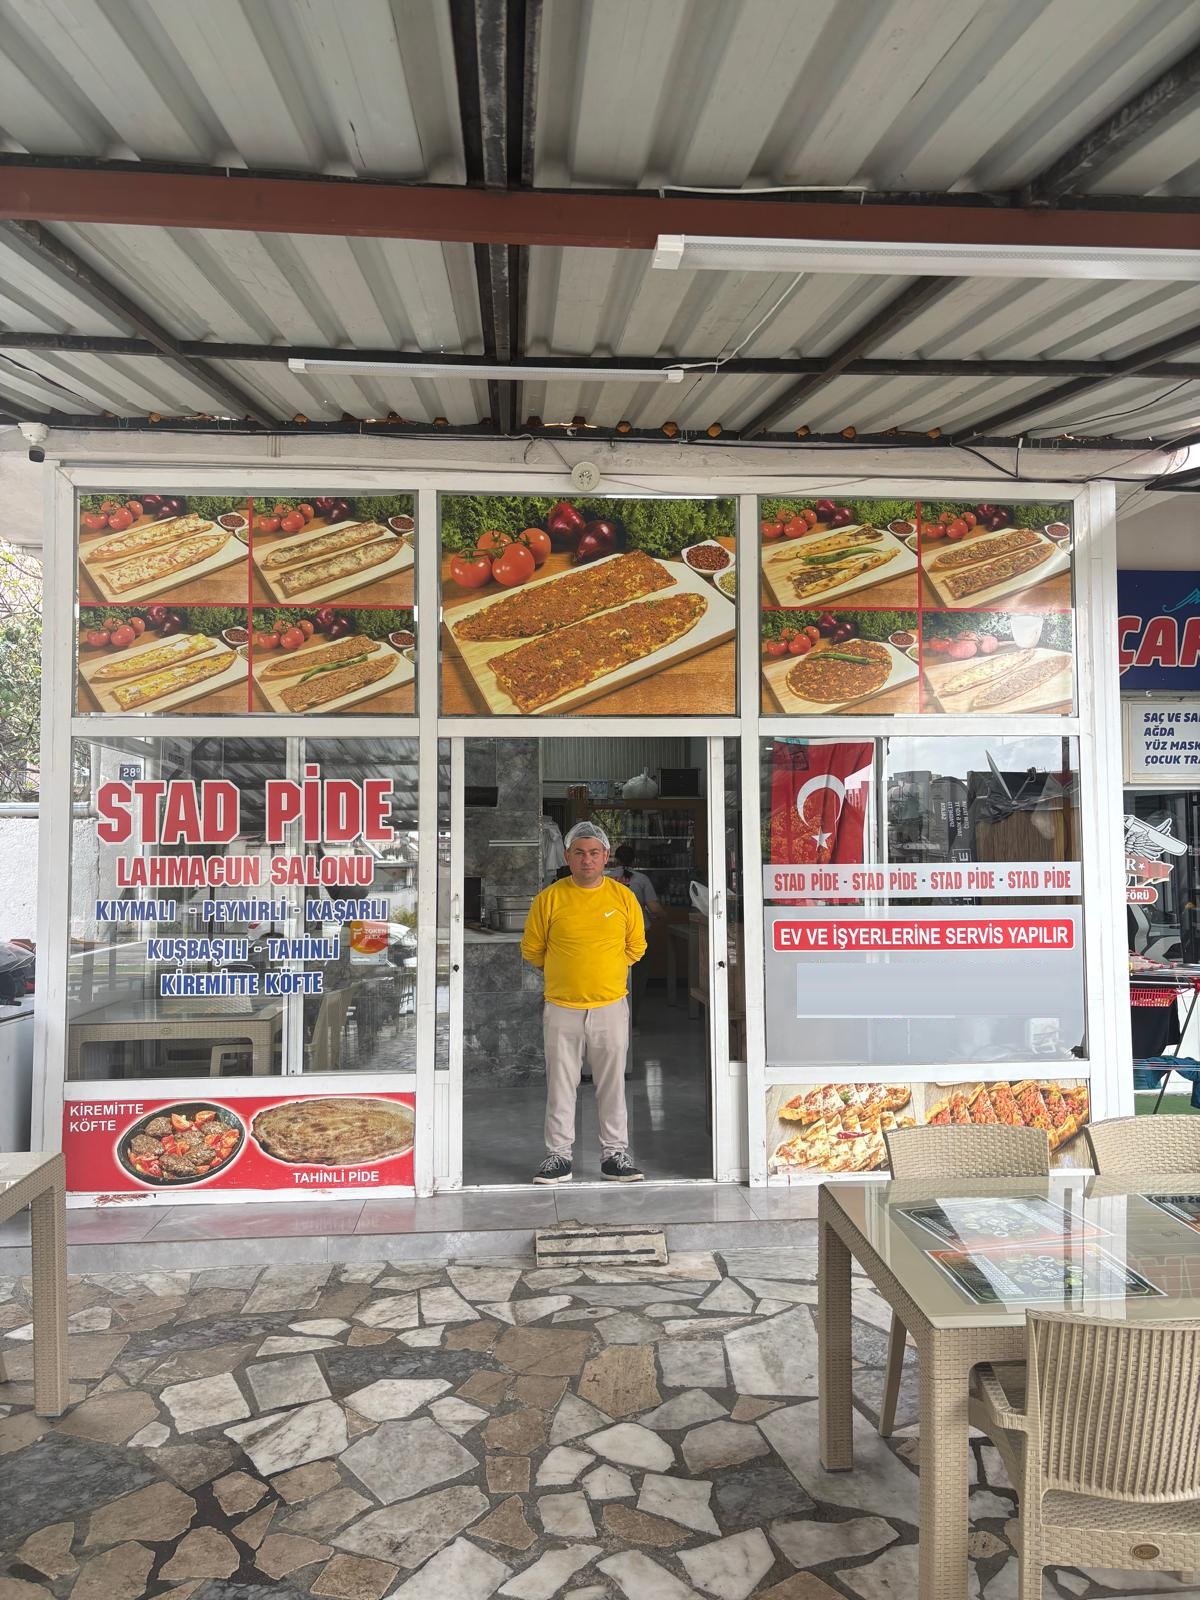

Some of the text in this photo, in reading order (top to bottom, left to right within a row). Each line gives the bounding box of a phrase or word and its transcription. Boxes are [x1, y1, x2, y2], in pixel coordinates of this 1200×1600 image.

[1144, 712, 1200, 724] SAÇ VE SA
[1144, 725, 1174, 736] AĞDA
[1145, 739, 1167, 750] YÜZ
[1145, 755, 1200, 766] ÇOCUK TR
[96, 763, 394, 844] STAD PİDE
[116, 855, 374, 887] LAHMACUN SALONU
[774, 873, 805, 891] STAD
[811, 868, 839, 891] PİDE
[852, 872, 884, 890] STAD
[889, 867, 917, 890] PİDE
[930, 871, 962, 889] STAD
[967, 867, 995, 889] PİDE
[1008, 871, 1039, 889] STAD
[1044, 866, 1071, 888] PİDE
[96, 900, 176, 922] KIYMALI
[202, 896, 287, 922] PEYNİRLİ
[306, 899, 388, 926] KAŞARLI
[781, 923, 1068, 949] EV VE İŞYERLERİNE SERVİS YAPILIR
[147, 938, 248, 965] KUŞBAŞILI
[267, 933, 340, 960] TAHİNLİ
[161, 968, 323, 996] KİREMİTTE KÖFTE
[70, 1103, 143, 1116] KİREMİTTE
[70, 1119, 116, 1132] KÖFTE
[293, 1170, 379, 1184] TAHİNLİ PİDE
